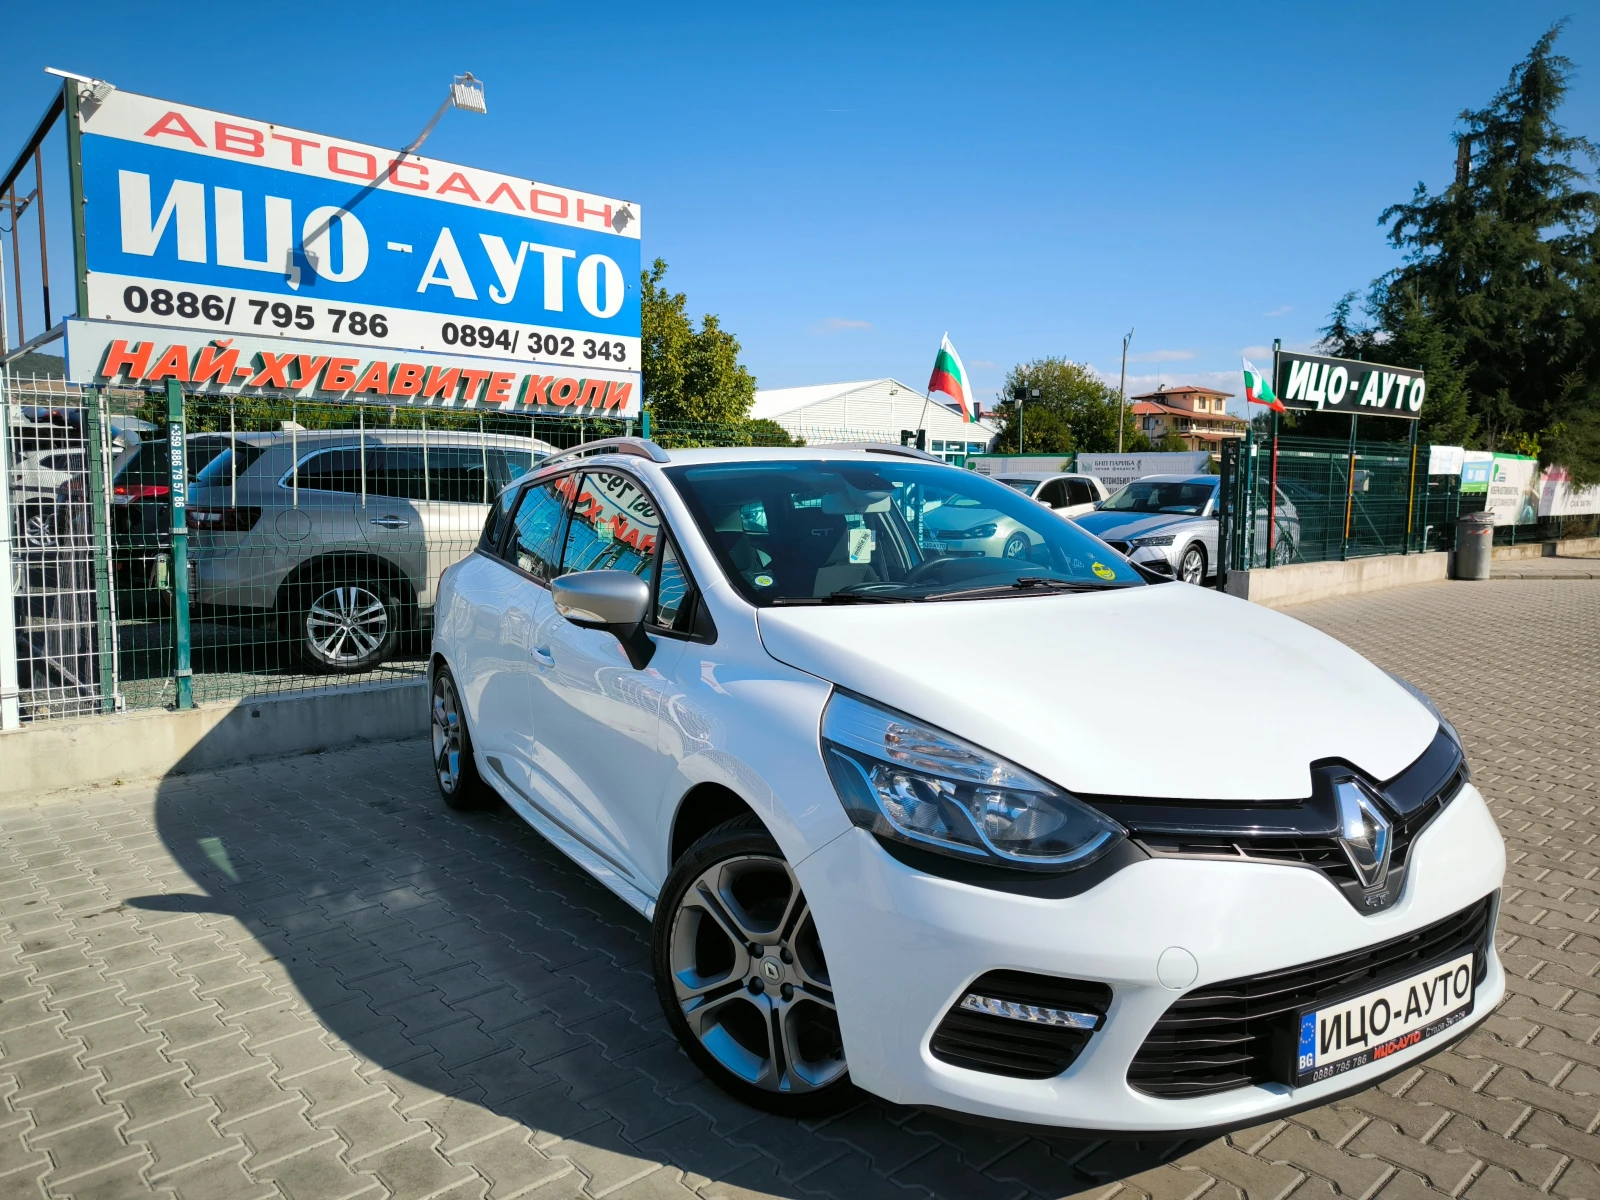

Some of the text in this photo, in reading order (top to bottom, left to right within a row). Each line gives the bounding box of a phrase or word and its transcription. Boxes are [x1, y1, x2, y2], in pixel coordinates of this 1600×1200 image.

[144, 111, 612, 228] АВТОСАЛОН
[124, 285, 388, 338] 0886/ 795 786
[442, 322, 626, 362] 0894/ 302 343
[102, 338, 633, 410] НАЙ-ХУБАВИТЕ КОЛИ
[171, 424, 185, 508] +359 886 79 57 86
[1320, 964, 1470, 1055] ИЦО-АУТО
[1299, 1053, 1314, 1069] BG
[1313, 1054, 1367, 1082] 0886 795 786
[1374, 1030, 1421, 1060] ИЦО-АУТО
